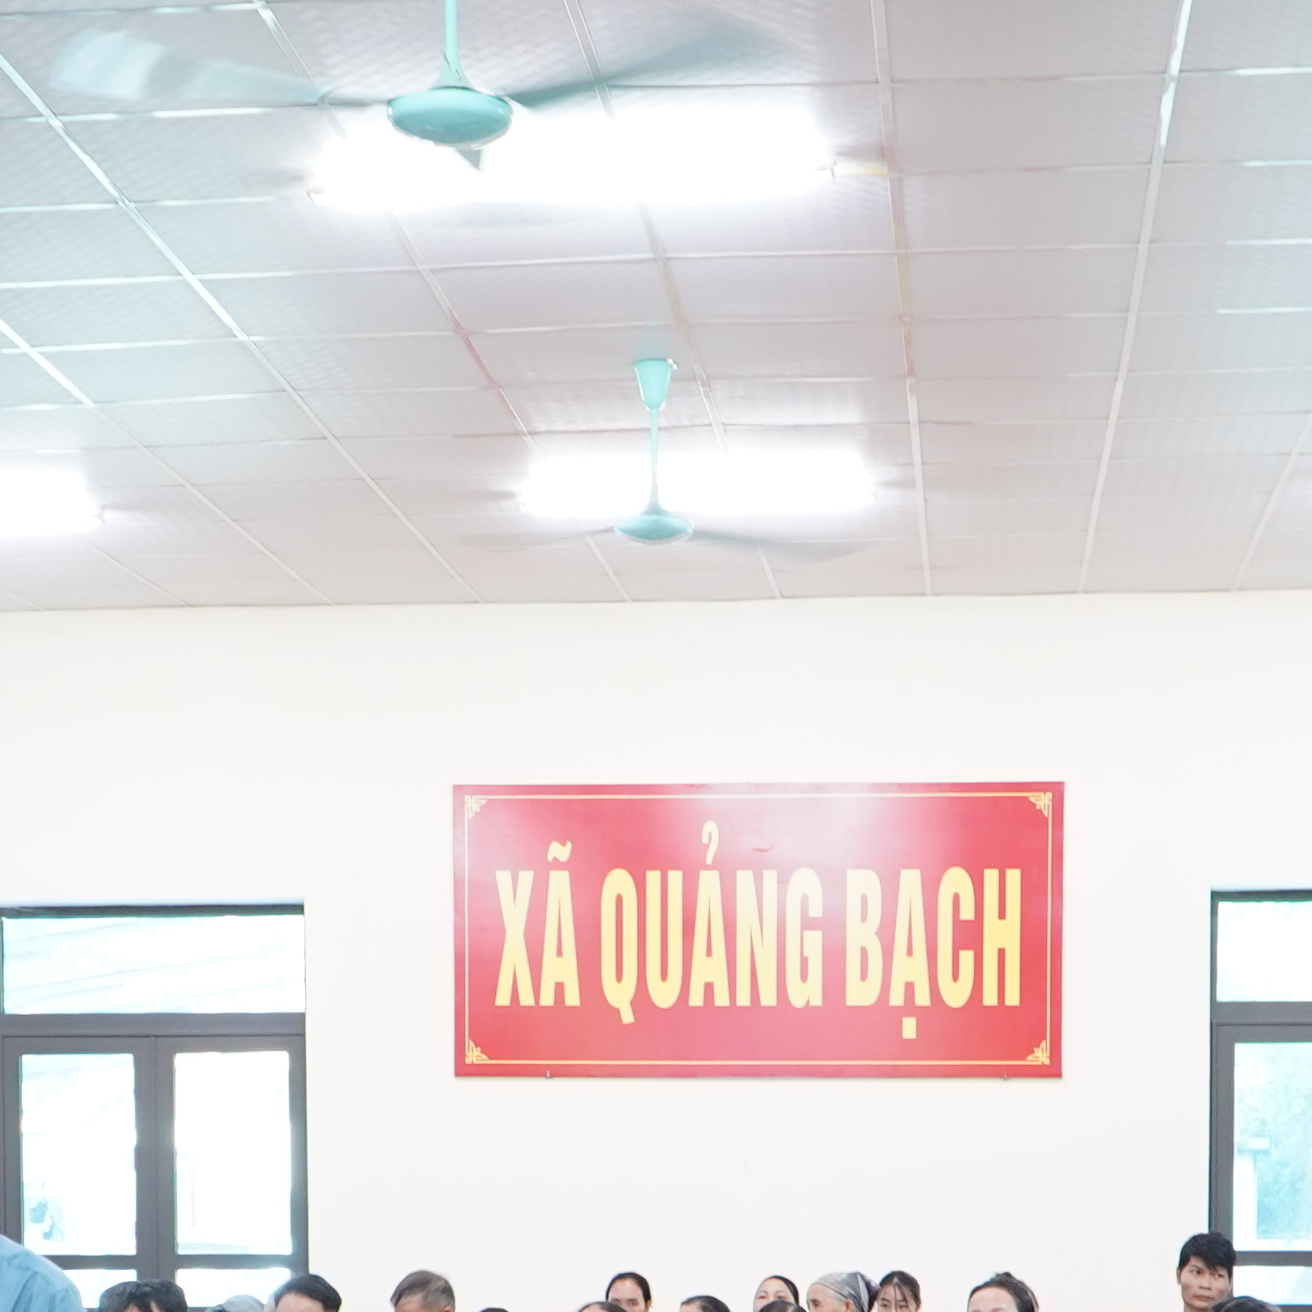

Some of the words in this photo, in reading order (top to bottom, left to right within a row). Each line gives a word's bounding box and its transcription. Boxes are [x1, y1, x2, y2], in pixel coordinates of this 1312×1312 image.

[494, 840, 581, 1007] XÃ
[600, 821, 824, 1025] QUẢNG
[845, 866, 1022, 1040] BẠCH
